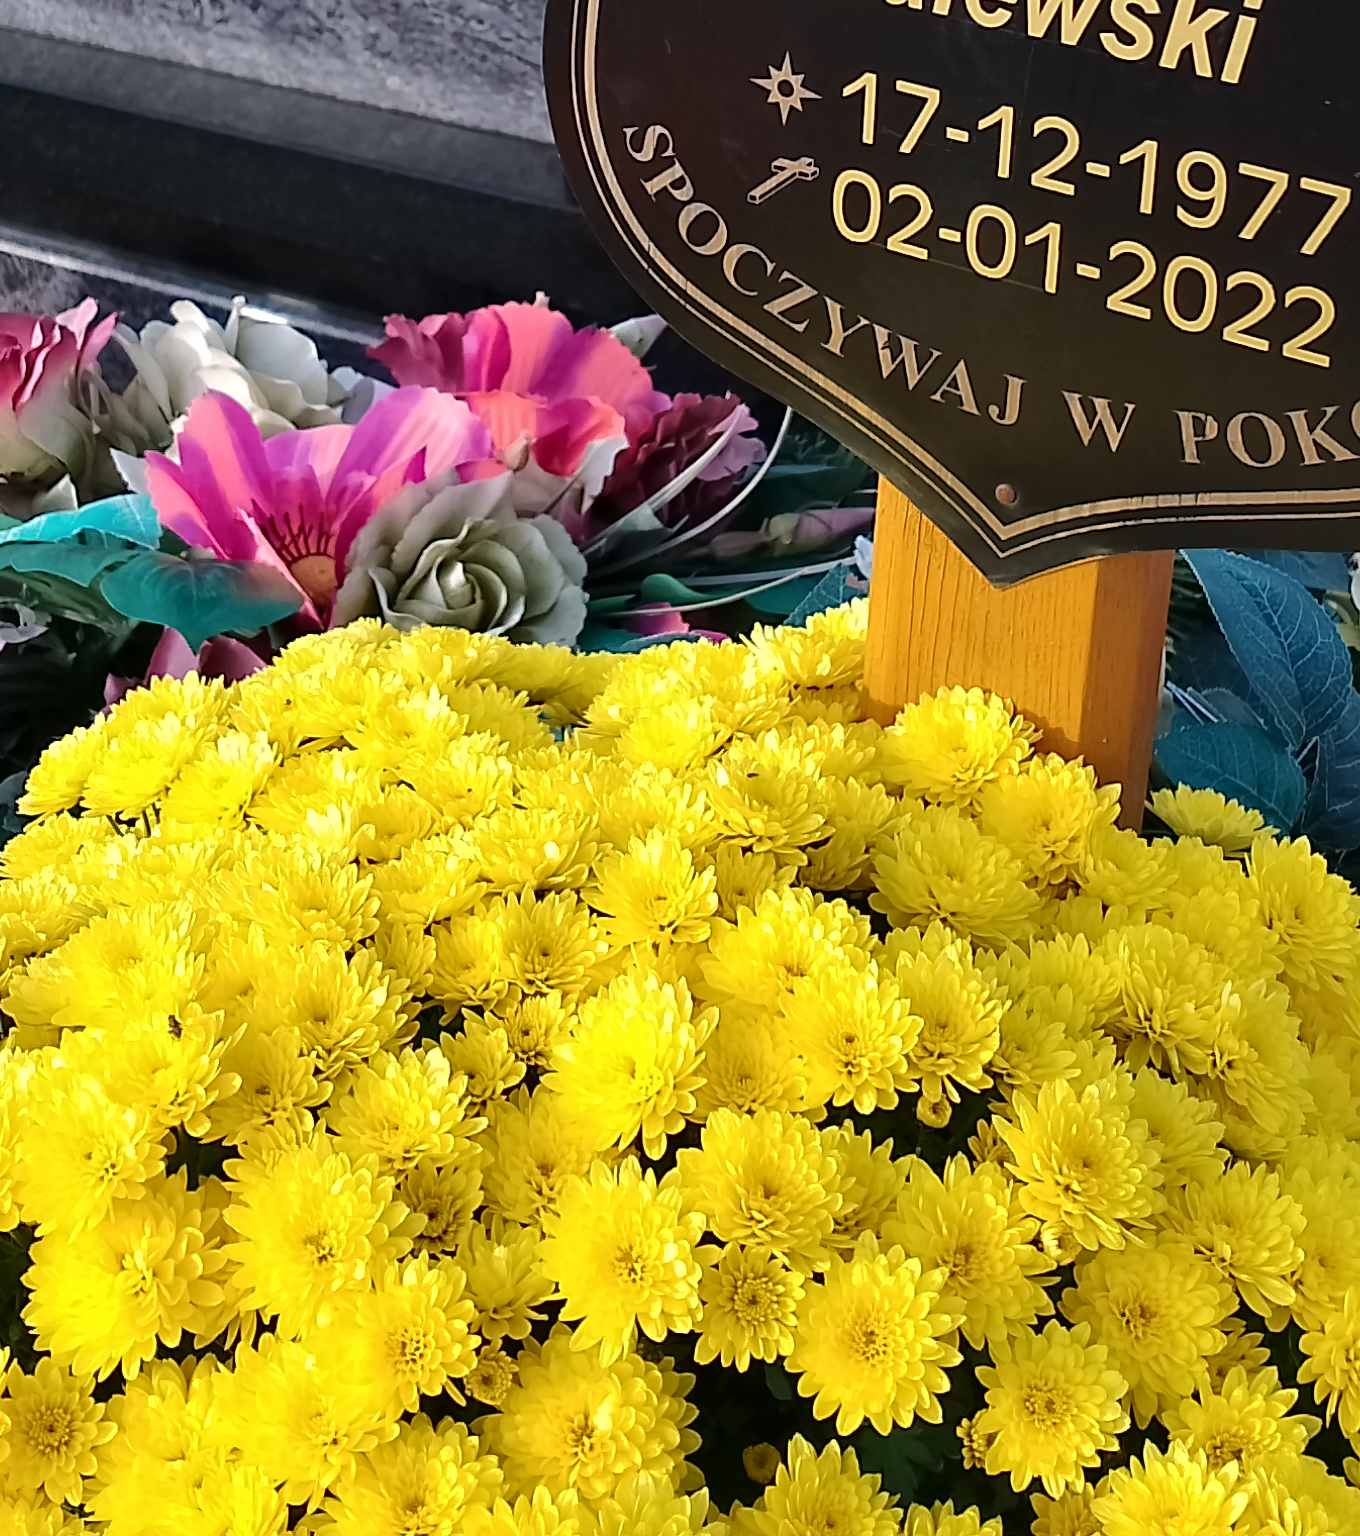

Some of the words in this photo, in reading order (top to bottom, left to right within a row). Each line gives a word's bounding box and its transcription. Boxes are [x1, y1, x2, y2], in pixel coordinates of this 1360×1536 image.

[840, 70, 1353, 257] 17-12-1977
[621, 122, 1028, 427] SPOCZYWAJ
[1060, 389, 1137, 454] W
[831, 168, 1337, 369] 02-01-2022
